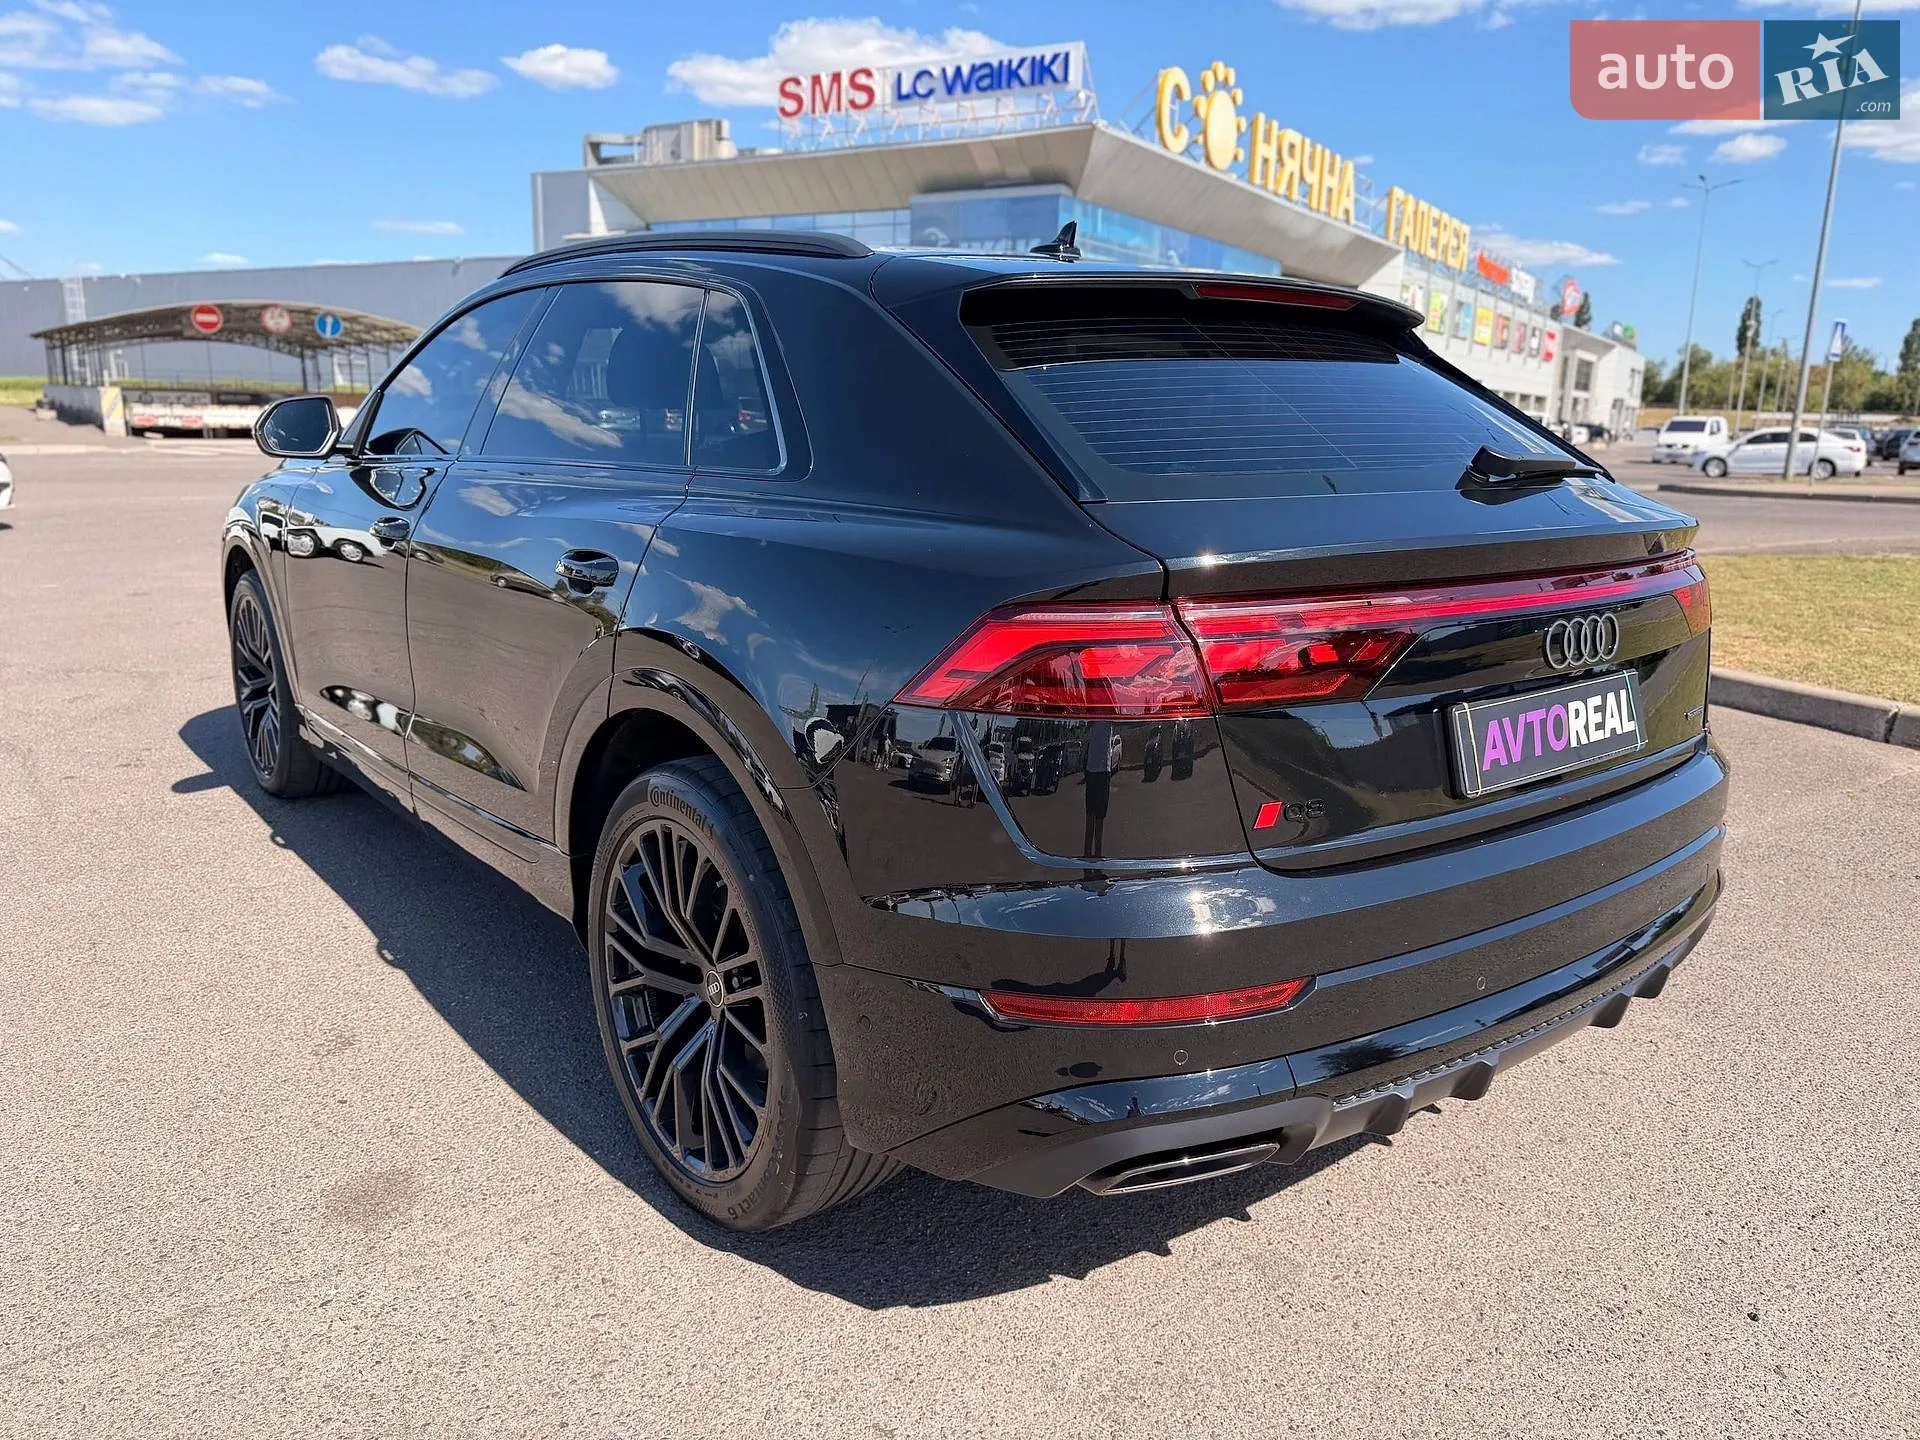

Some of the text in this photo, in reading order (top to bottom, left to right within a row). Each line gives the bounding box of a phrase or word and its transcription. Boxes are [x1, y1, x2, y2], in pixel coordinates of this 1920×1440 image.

[778, 67, 876, 119] SMS
[896, 69, 935, 101] LC
[1385, 185, 1470, 273] ГАЛЕРЕЯ
[1482, 688, 1635, 772] AVTOREAL
[650, 785, 707, 831] Continental
[1284, 799, 1326, 824] Q8
